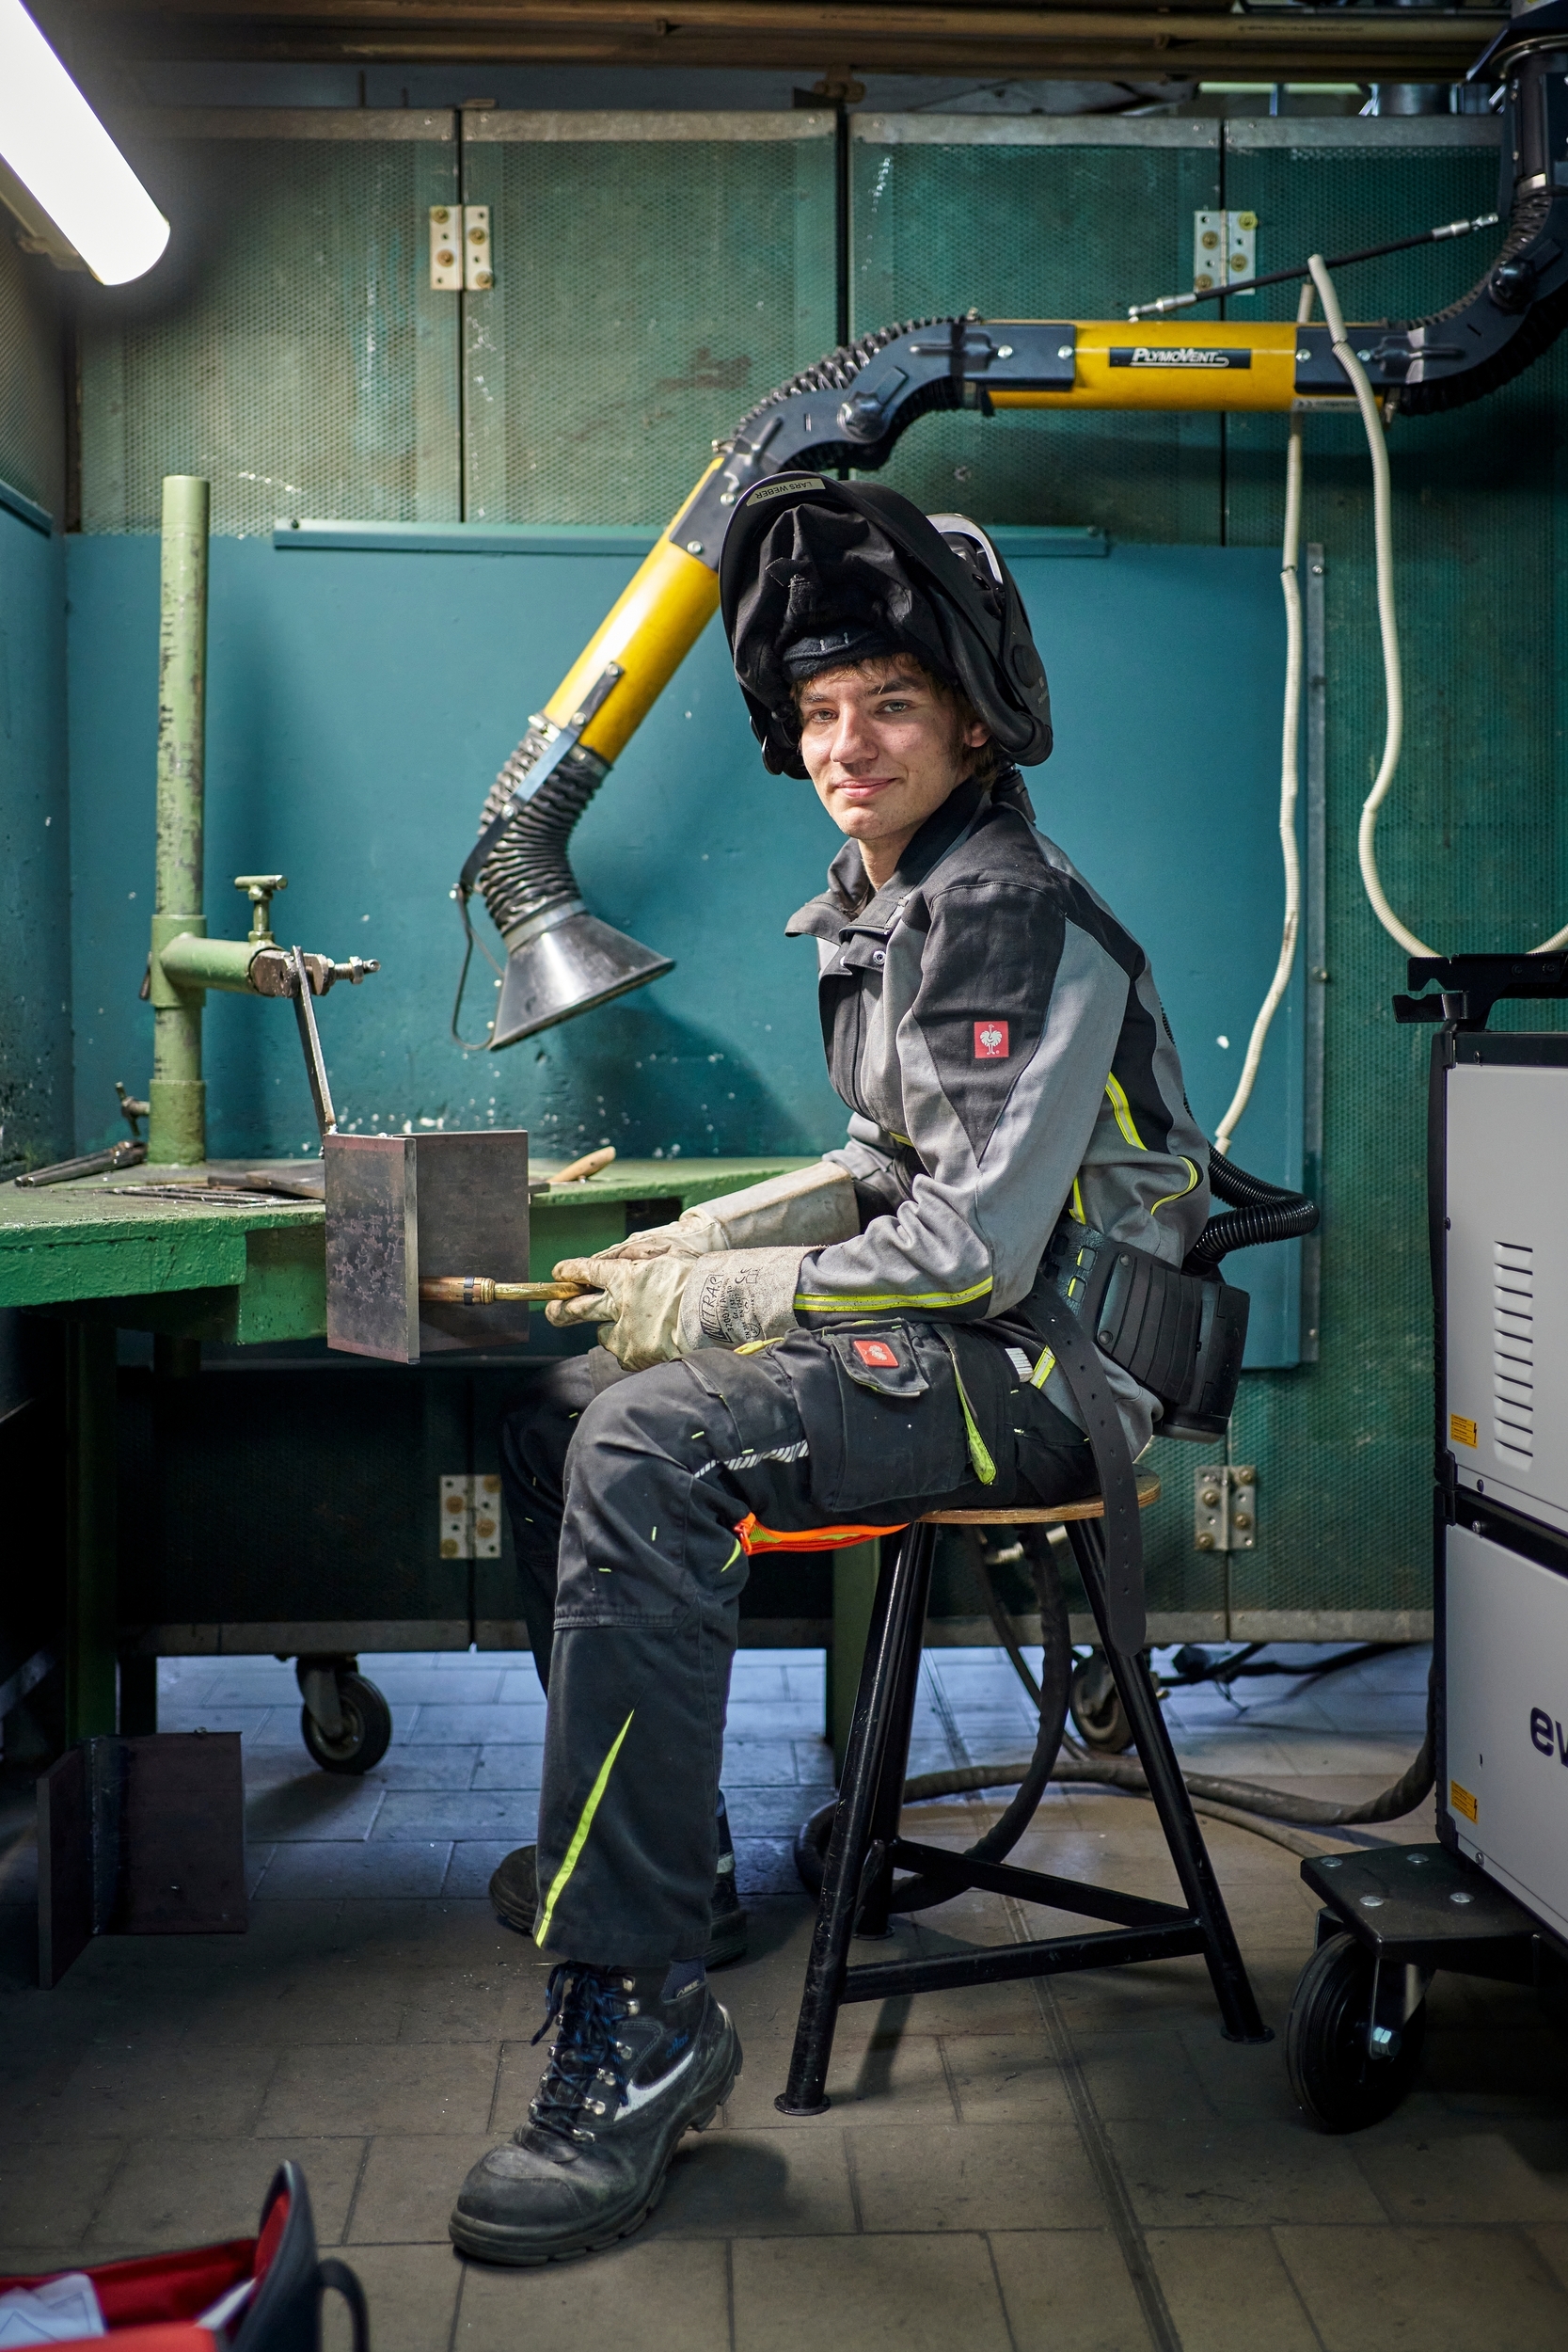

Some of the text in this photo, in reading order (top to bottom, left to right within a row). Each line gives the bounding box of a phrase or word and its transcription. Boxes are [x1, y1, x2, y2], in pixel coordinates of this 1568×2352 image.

[755, 481, 812, 499] LARS WEBER
[701, 1276, 729, 1340] NITRAS
